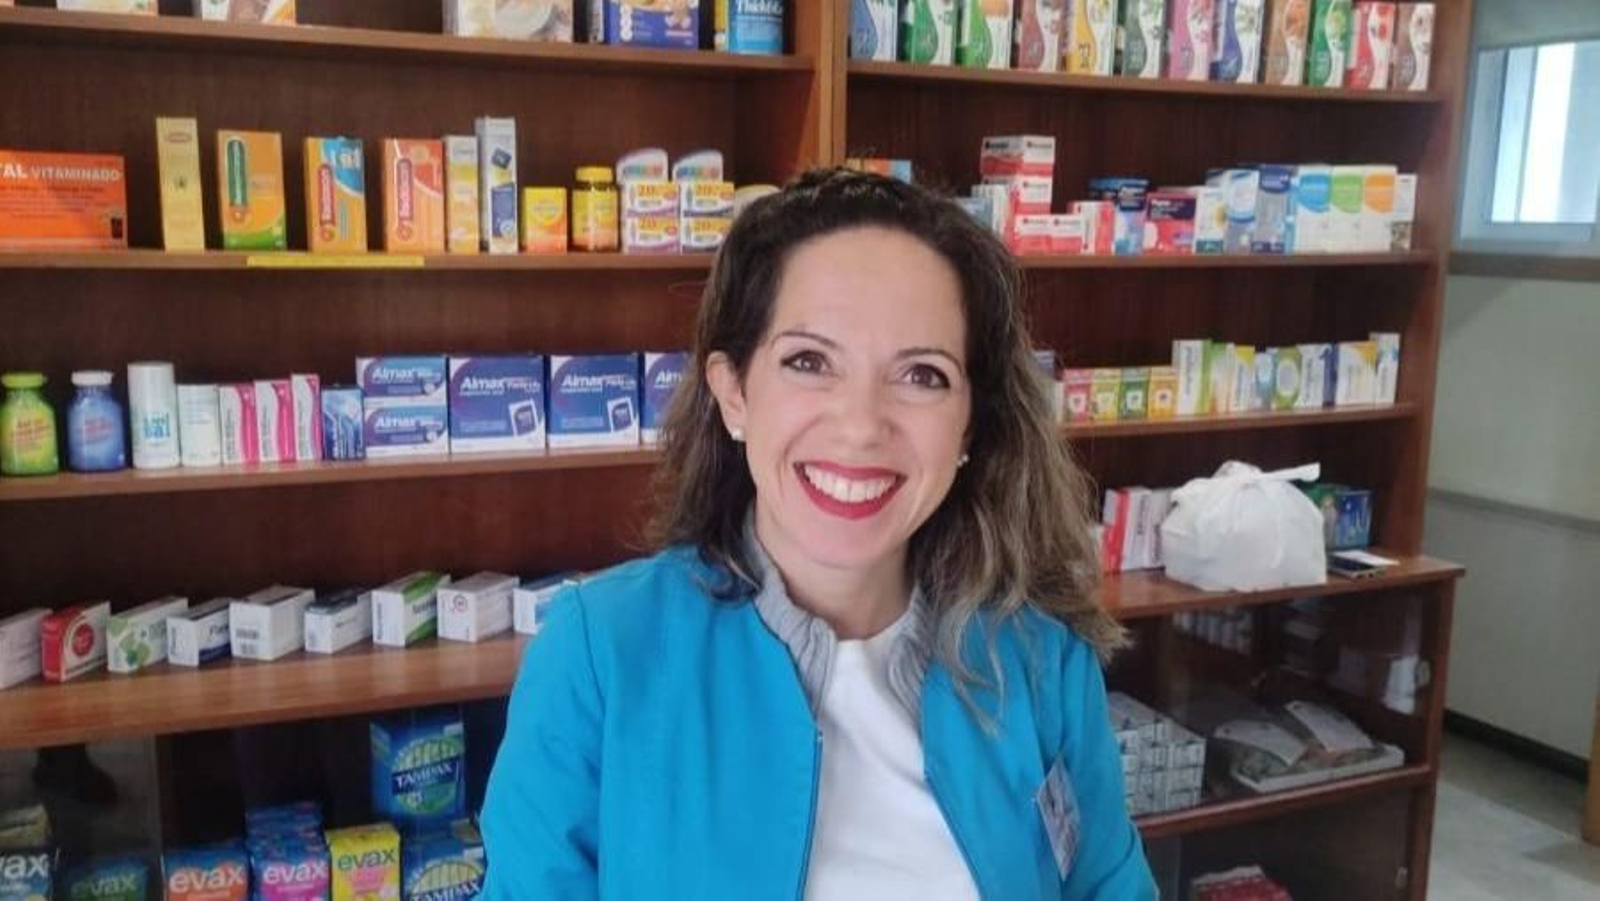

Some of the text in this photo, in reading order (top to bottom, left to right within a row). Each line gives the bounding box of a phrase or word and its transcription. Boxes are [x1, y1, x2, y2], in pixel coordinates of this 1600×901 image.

[30, 166, 120, 182] VITAMINADO
[372, 367, 413, 380] Almax
[461, 376, 504, 390] Almax
[562, 374, 604, 387] Almax
[375, 416, 415, 428] Almax
[394, 762, 454, 789] TAMPAX
[338, 848, 396, 870] evax
[169, 863, 245, 894] evax
[263, 860, 327, 884] evax
[70, 872, 138, 898] evax
